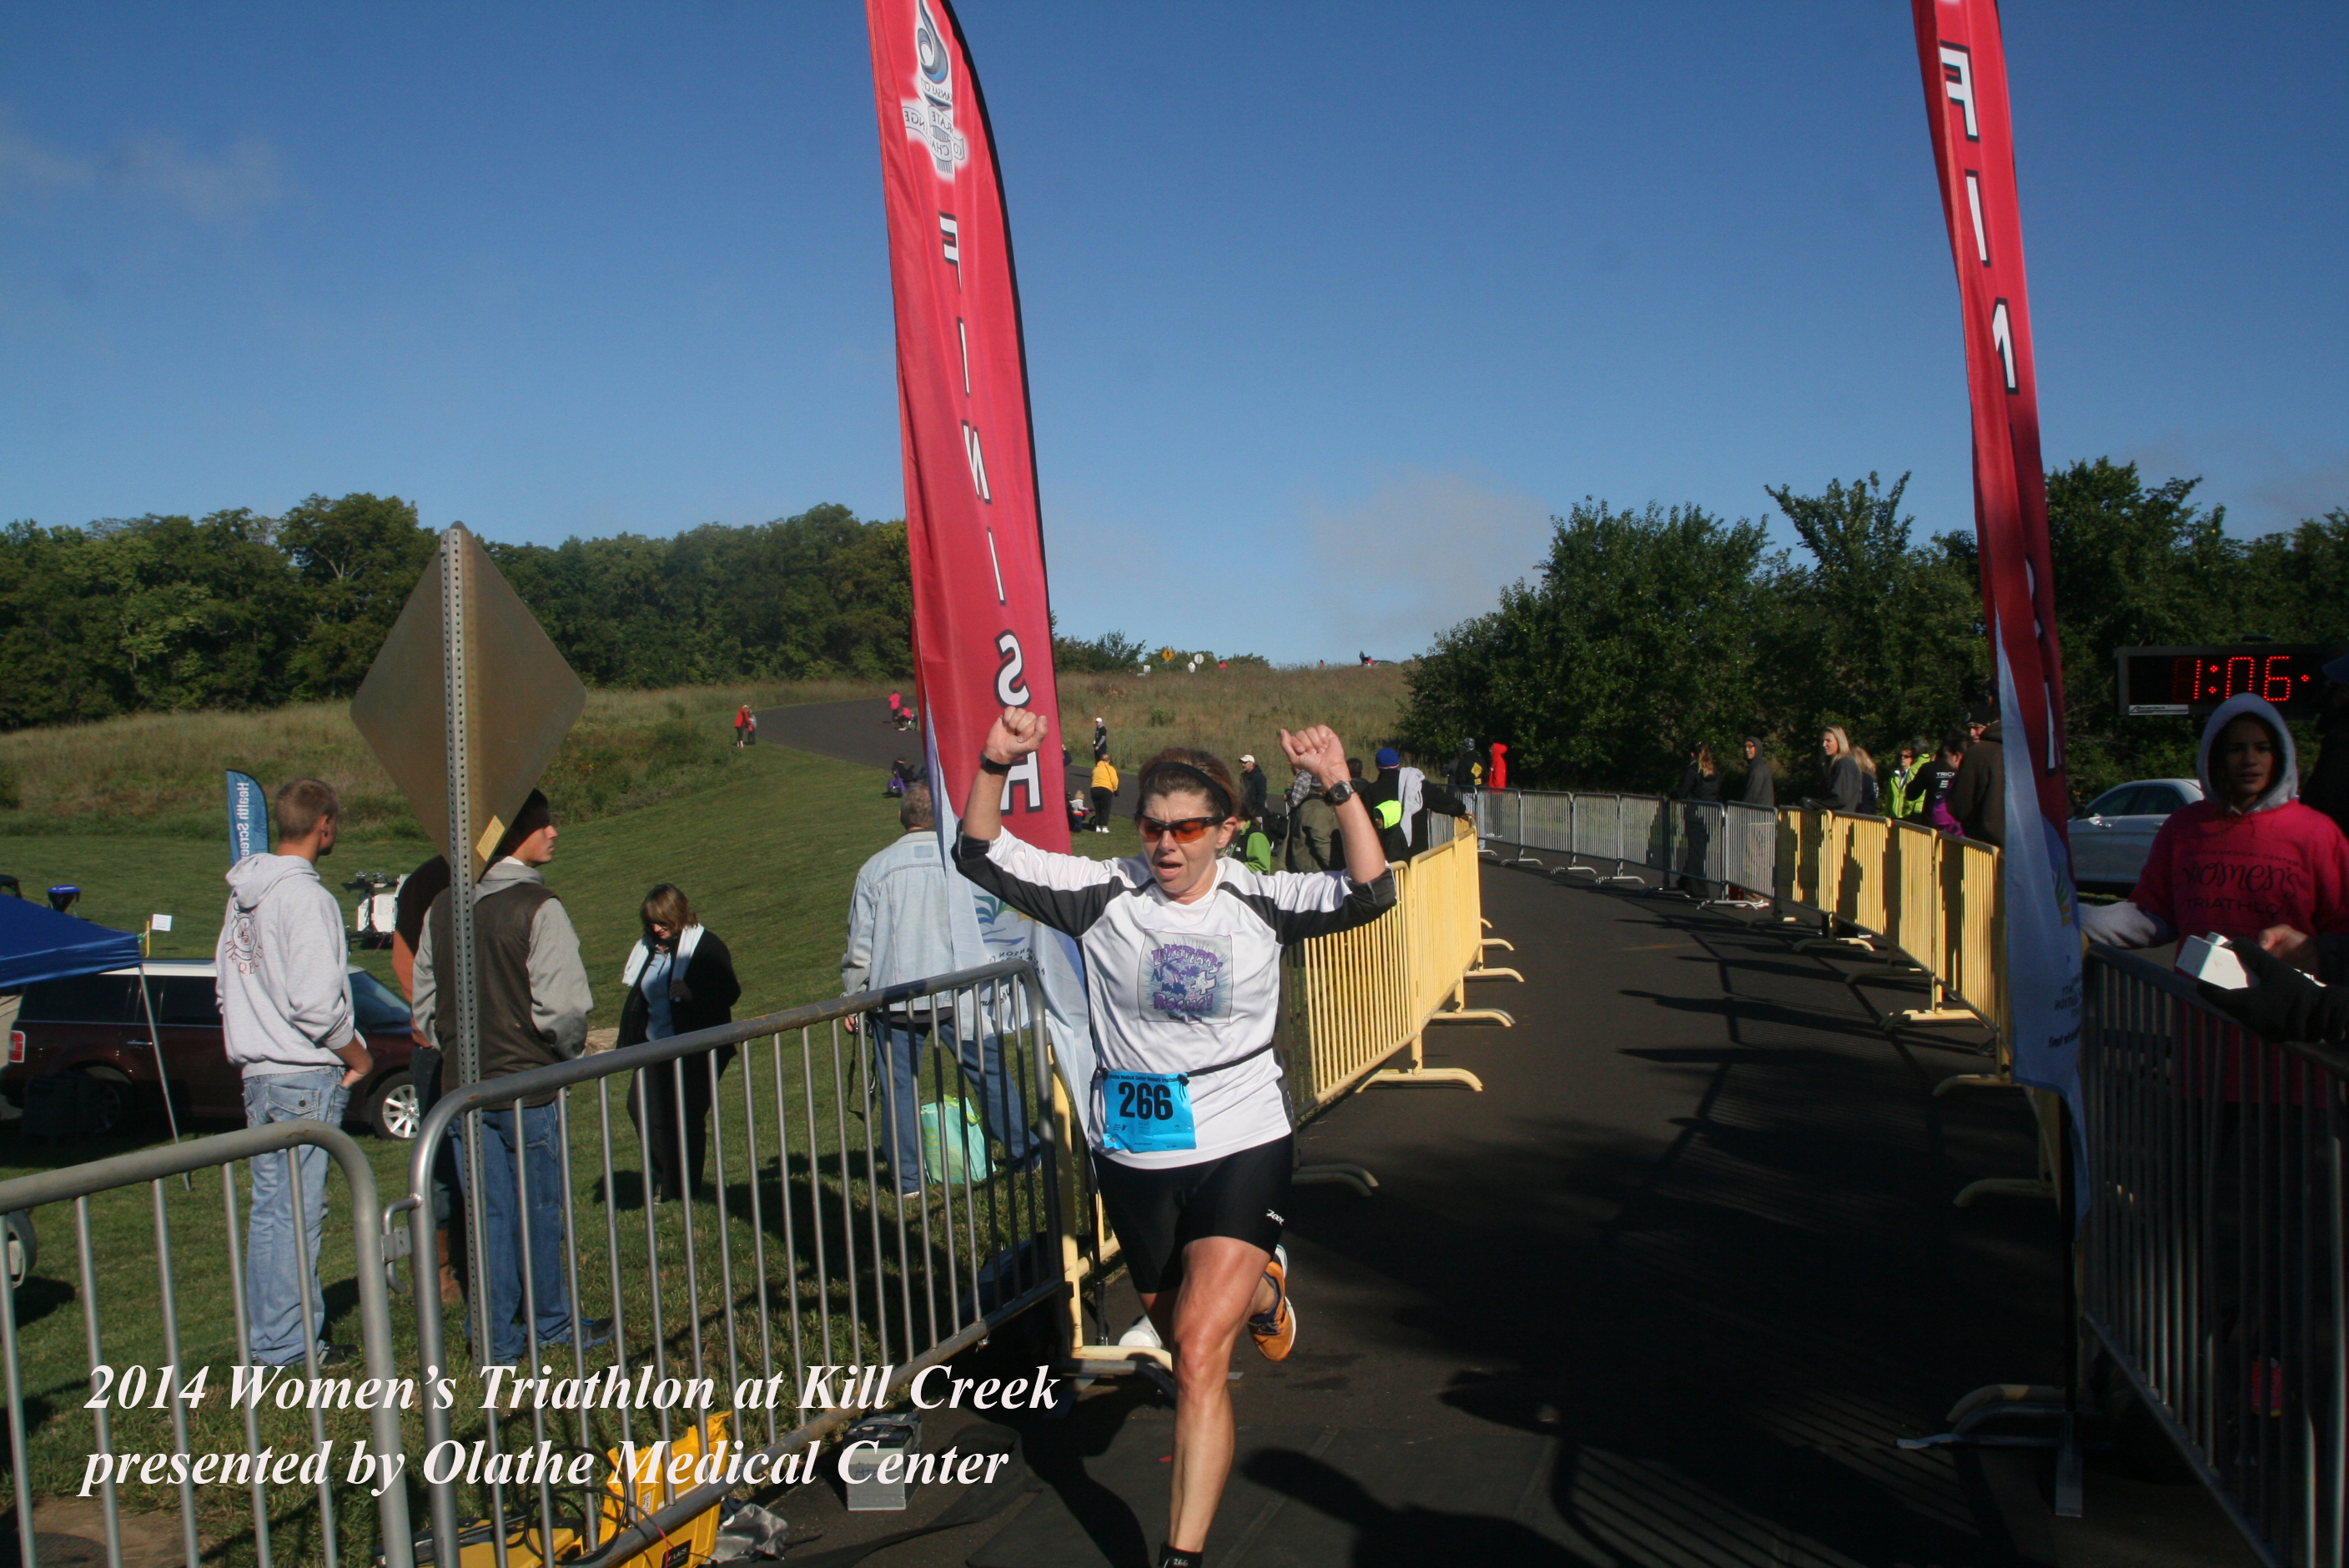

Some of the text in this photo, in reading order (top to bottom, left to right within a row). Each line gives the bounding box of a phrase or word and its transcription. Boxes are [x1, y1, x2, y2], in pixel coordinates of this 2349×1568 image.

[1151, 944, 1224, 974] LAKE PERRY
[1118, 1082, 1174, 1121] 266
